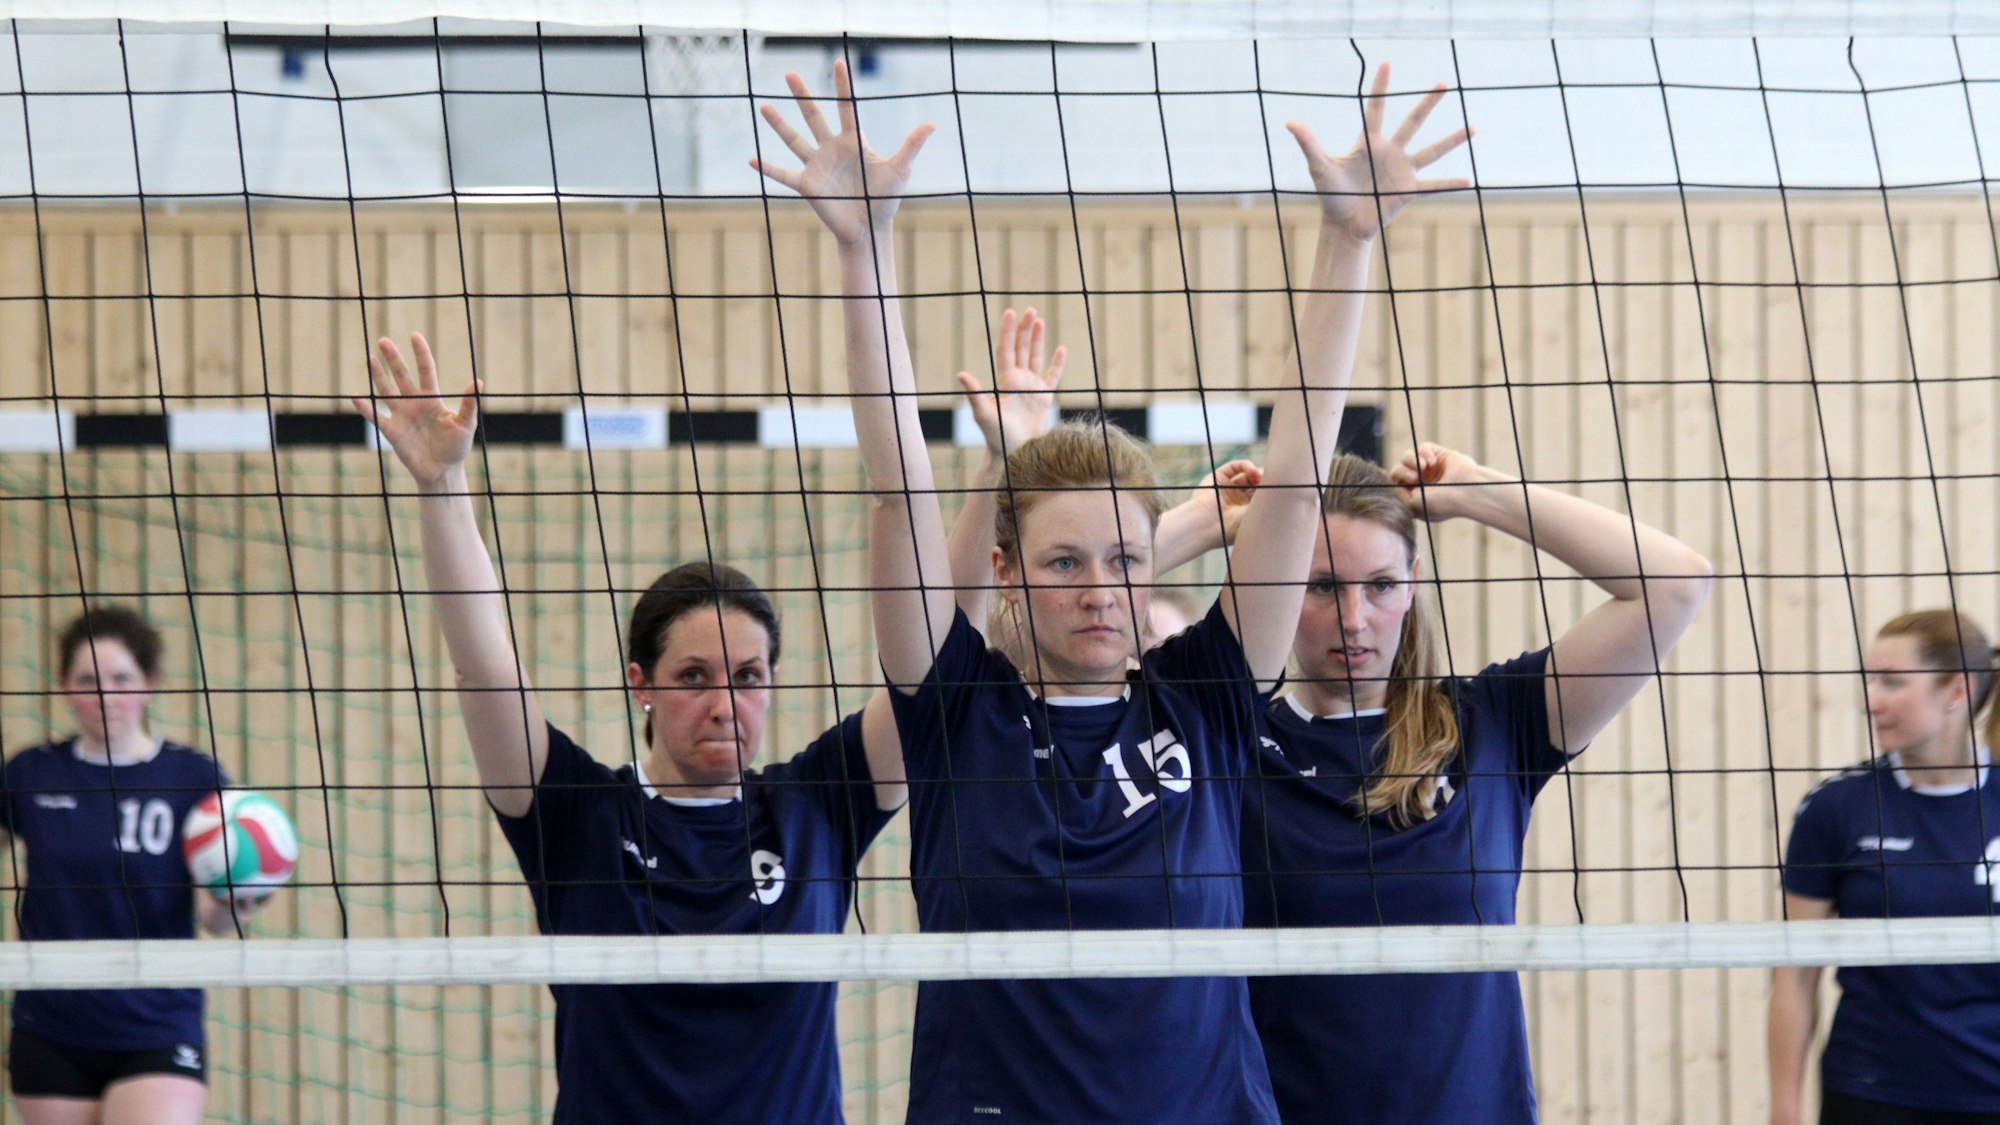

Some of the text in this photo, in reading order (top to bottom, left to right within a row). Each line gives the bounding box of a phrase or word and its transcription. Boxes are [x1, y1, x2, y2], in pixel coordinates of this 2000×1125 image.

[1102, 728, 1192, 819] 15
[116, 798, 175, 856] 10
[750, 849, 786, 905] 9
